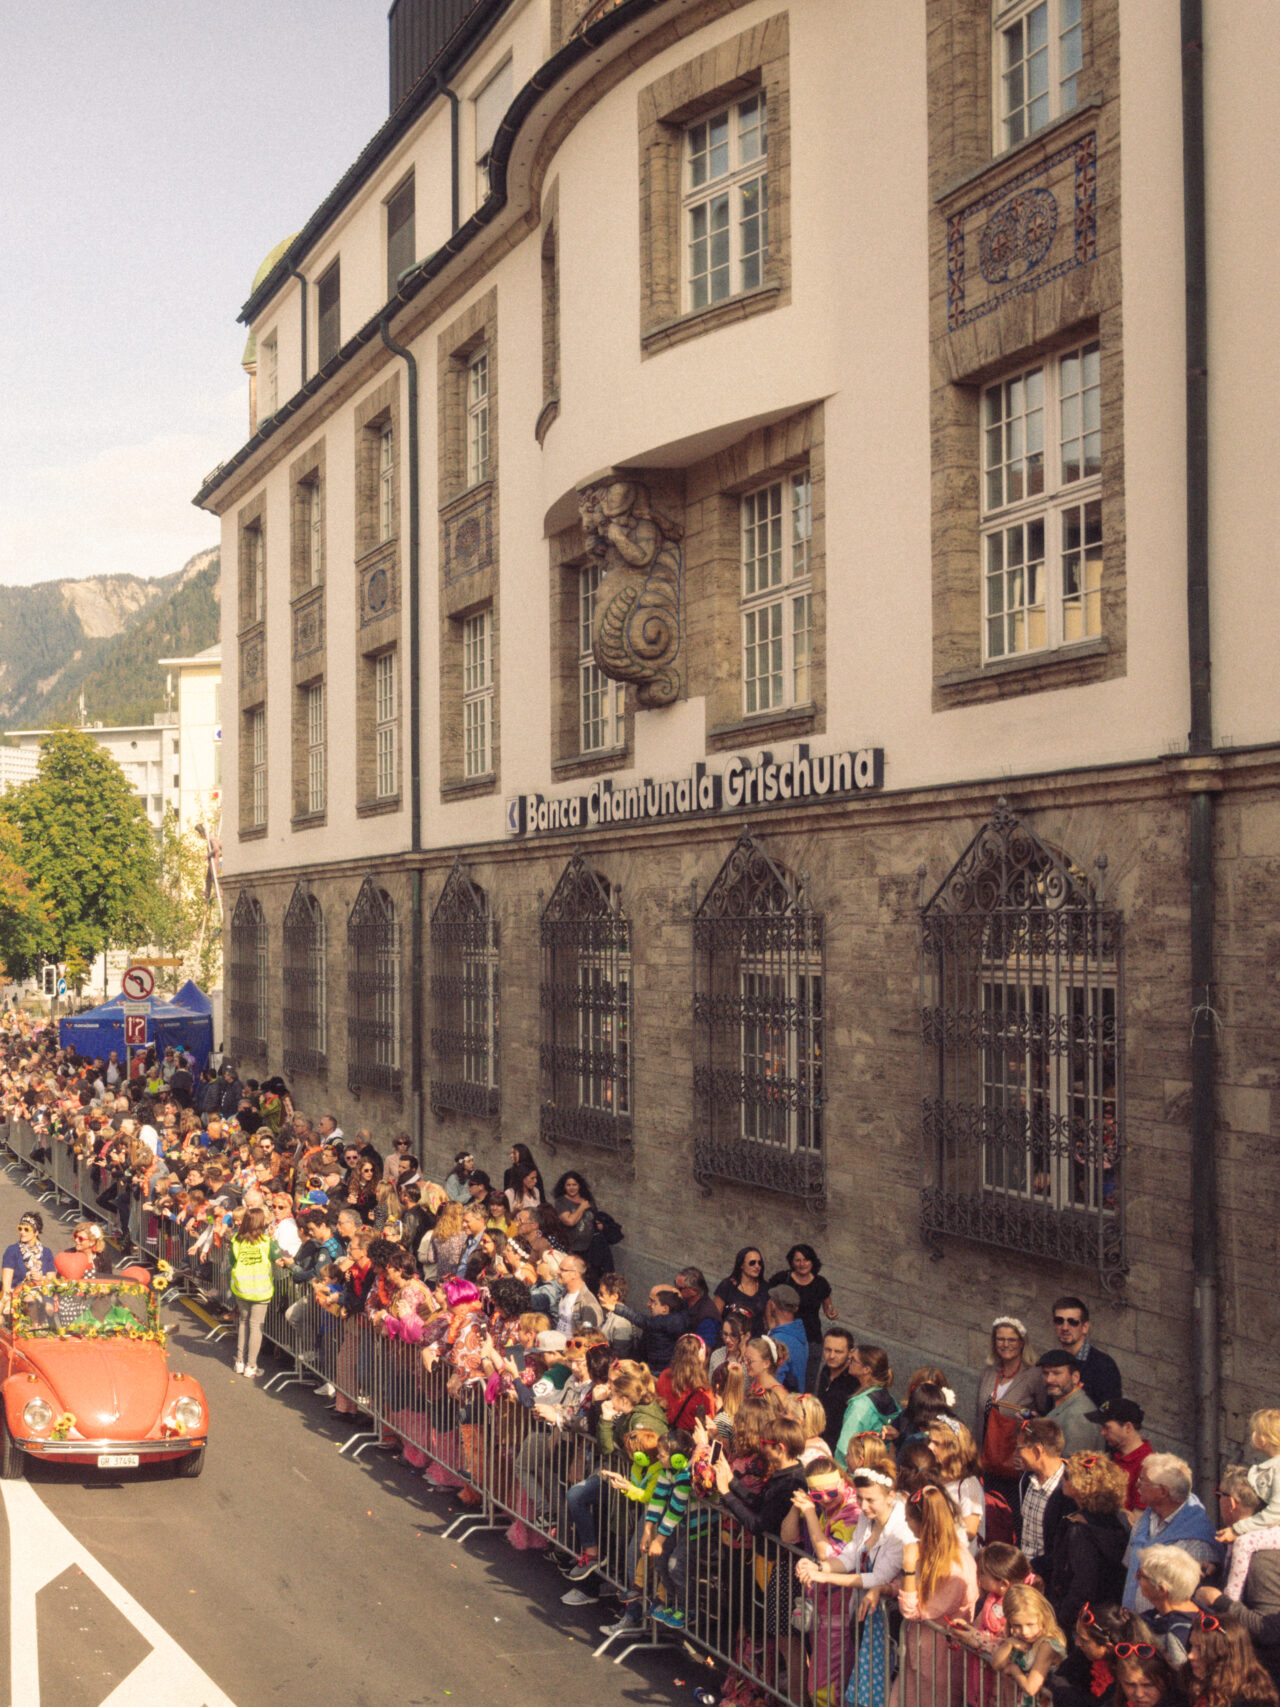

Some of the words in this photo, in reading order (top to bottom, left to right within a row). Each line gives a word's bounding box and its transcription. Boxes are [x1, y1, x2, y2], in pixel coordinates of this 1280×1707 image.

[526, 794, 582, 832] Banca
[587, 763, 715, 824] Chantunala
[724, 744, 876, 807] Grischuna
